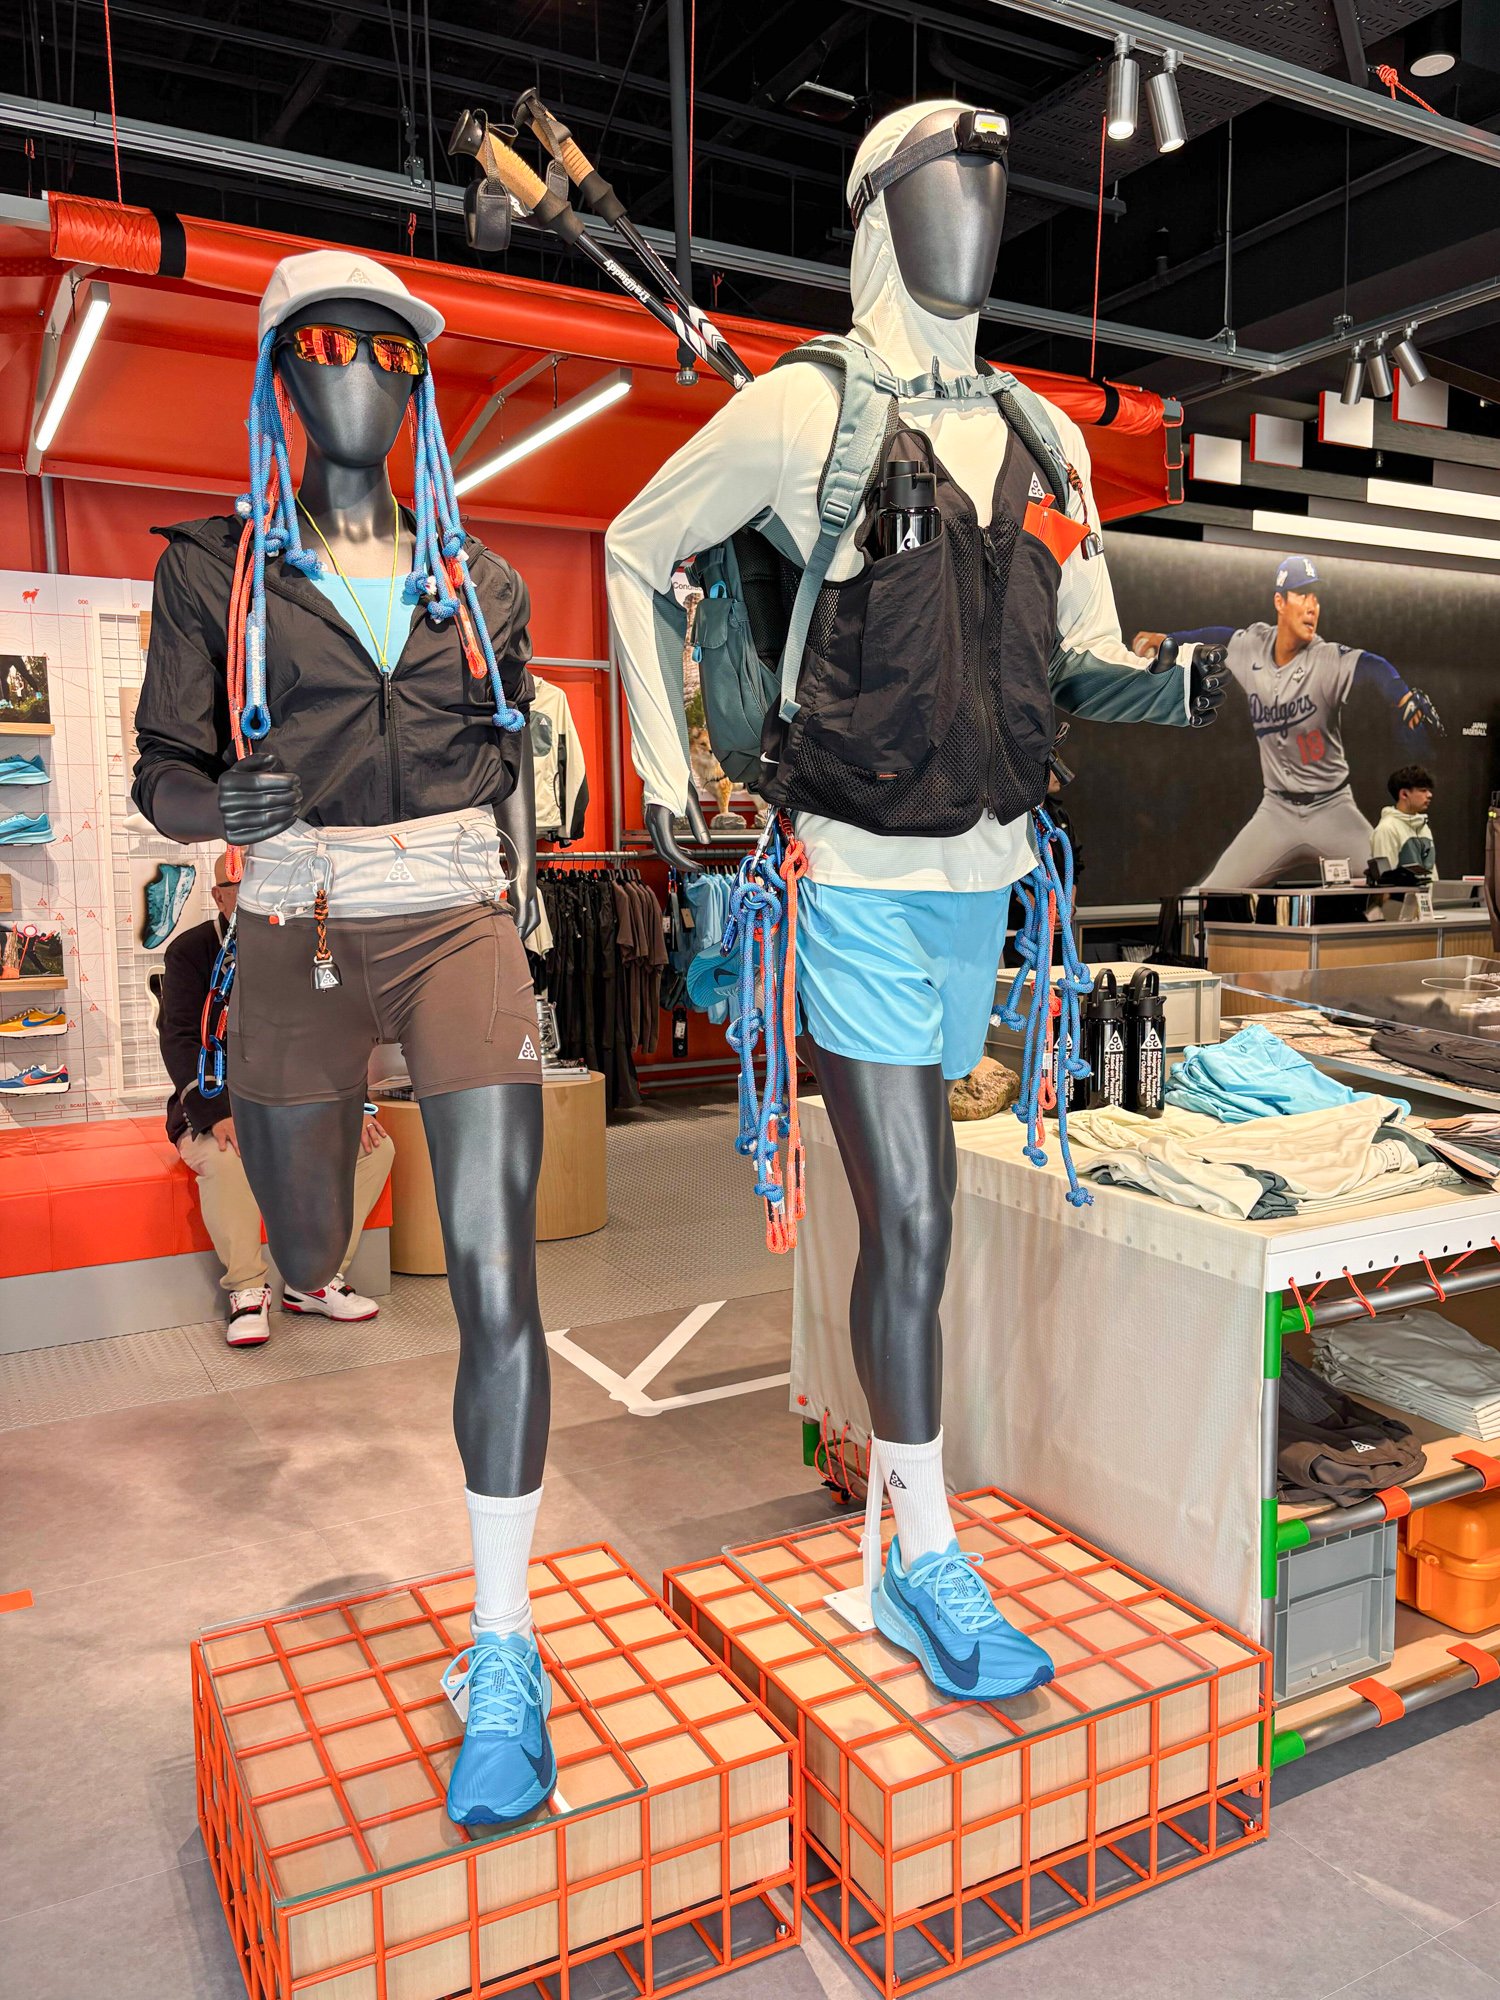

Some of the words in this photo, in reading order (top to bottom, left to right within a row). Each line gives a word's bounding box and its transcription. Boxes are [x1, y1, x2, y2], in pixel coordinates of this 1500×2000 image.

[604, 260, 650, 303] TrailBuddy
[1250, 693, 1317, 738] Dodgers
[1296, 728, 1324, 765] 18
